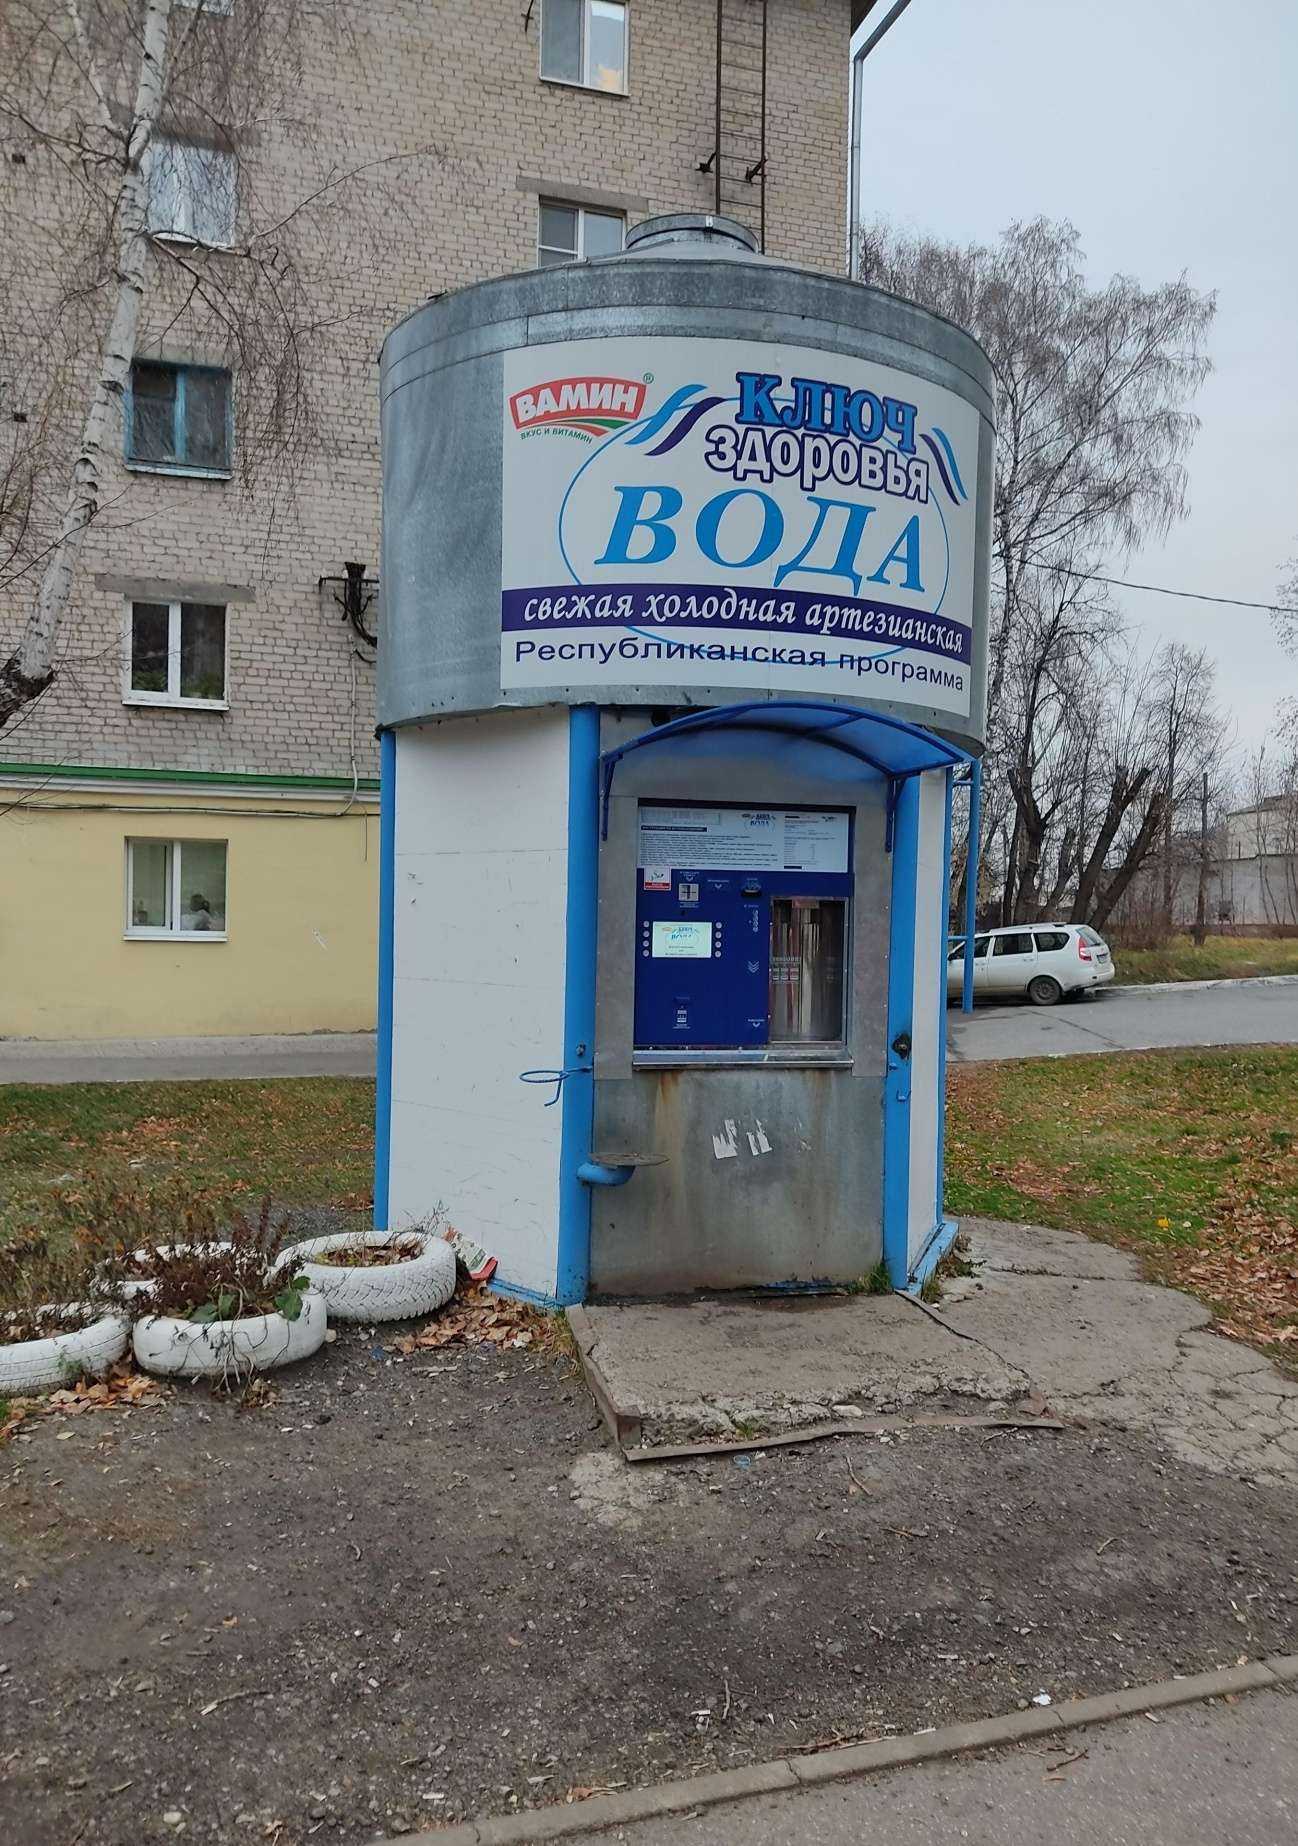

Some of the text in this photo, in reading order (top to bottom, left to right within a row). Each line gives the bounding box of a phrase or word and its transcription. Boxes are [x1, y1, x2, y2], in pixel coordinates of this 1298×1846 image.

[515, 382, 639, 424] ВАМИН
[736, 372, 918, 454] КЛЮЧ
[519, 429, 542, 440] ВКУС
[552, 428, 593, 444] ВИТАМИН
[593, 485, 927, 597] ВОДА
[523, 588, 964, 654] свежая холодная артезианская
[514, 637, 965, 691] Республиканская программа
